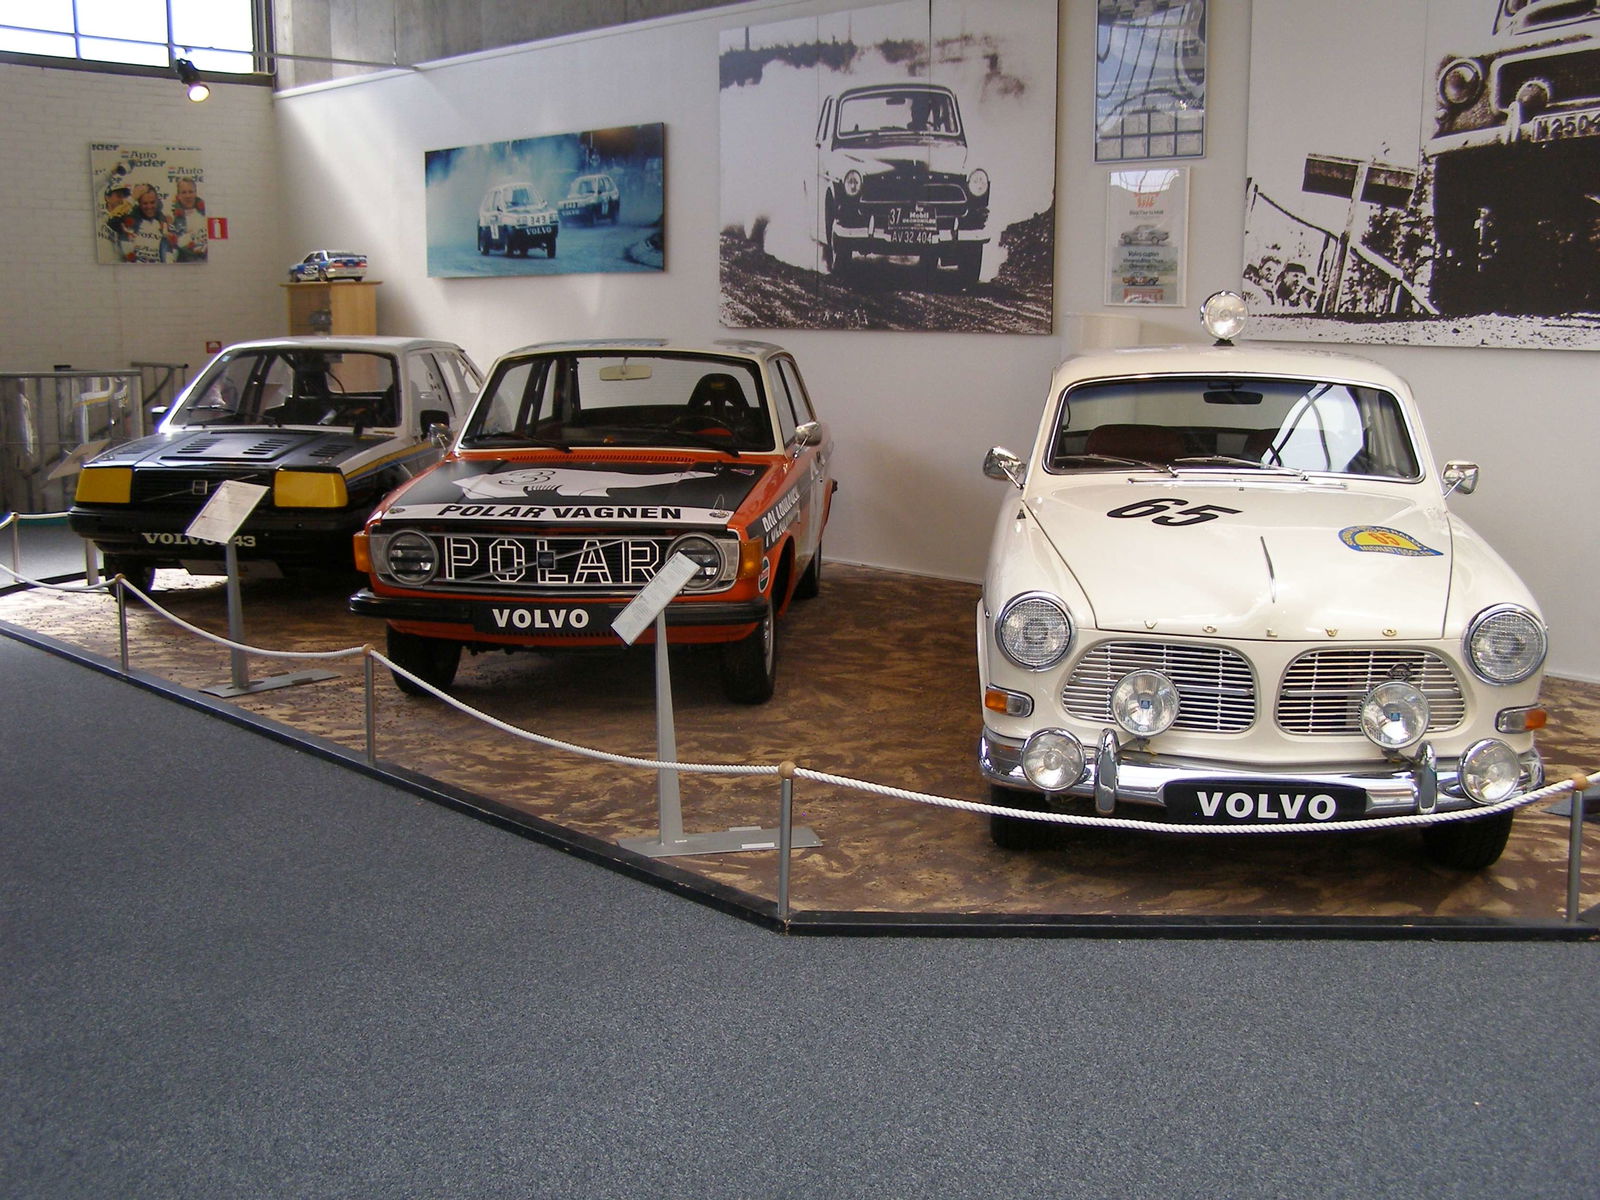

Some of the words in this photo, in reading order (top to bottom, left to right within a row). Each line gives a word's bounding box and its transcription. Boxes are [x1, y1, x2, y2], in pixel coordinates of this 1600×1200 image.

[131, 150, 157, 159] Auto
[177, 166, 203, 175] Auto
[889, 207, 902, 225] 37
[526, 226, 552, 235] VOLVO
[892, 231, 903, 242] AV
[904, 231, 914, 243] 32
[916, 231, 932, 243] 404
[437, 505, 546, 518] POLAR
[552, 507, 681, 519] VAGNEN
[1106, 498, 1243, 526] 65
[444, 536, 660, 584] POLAR
[492, 608, 590, 629] VOLVO
[1196, 791, 1337, 821] VOLVO
